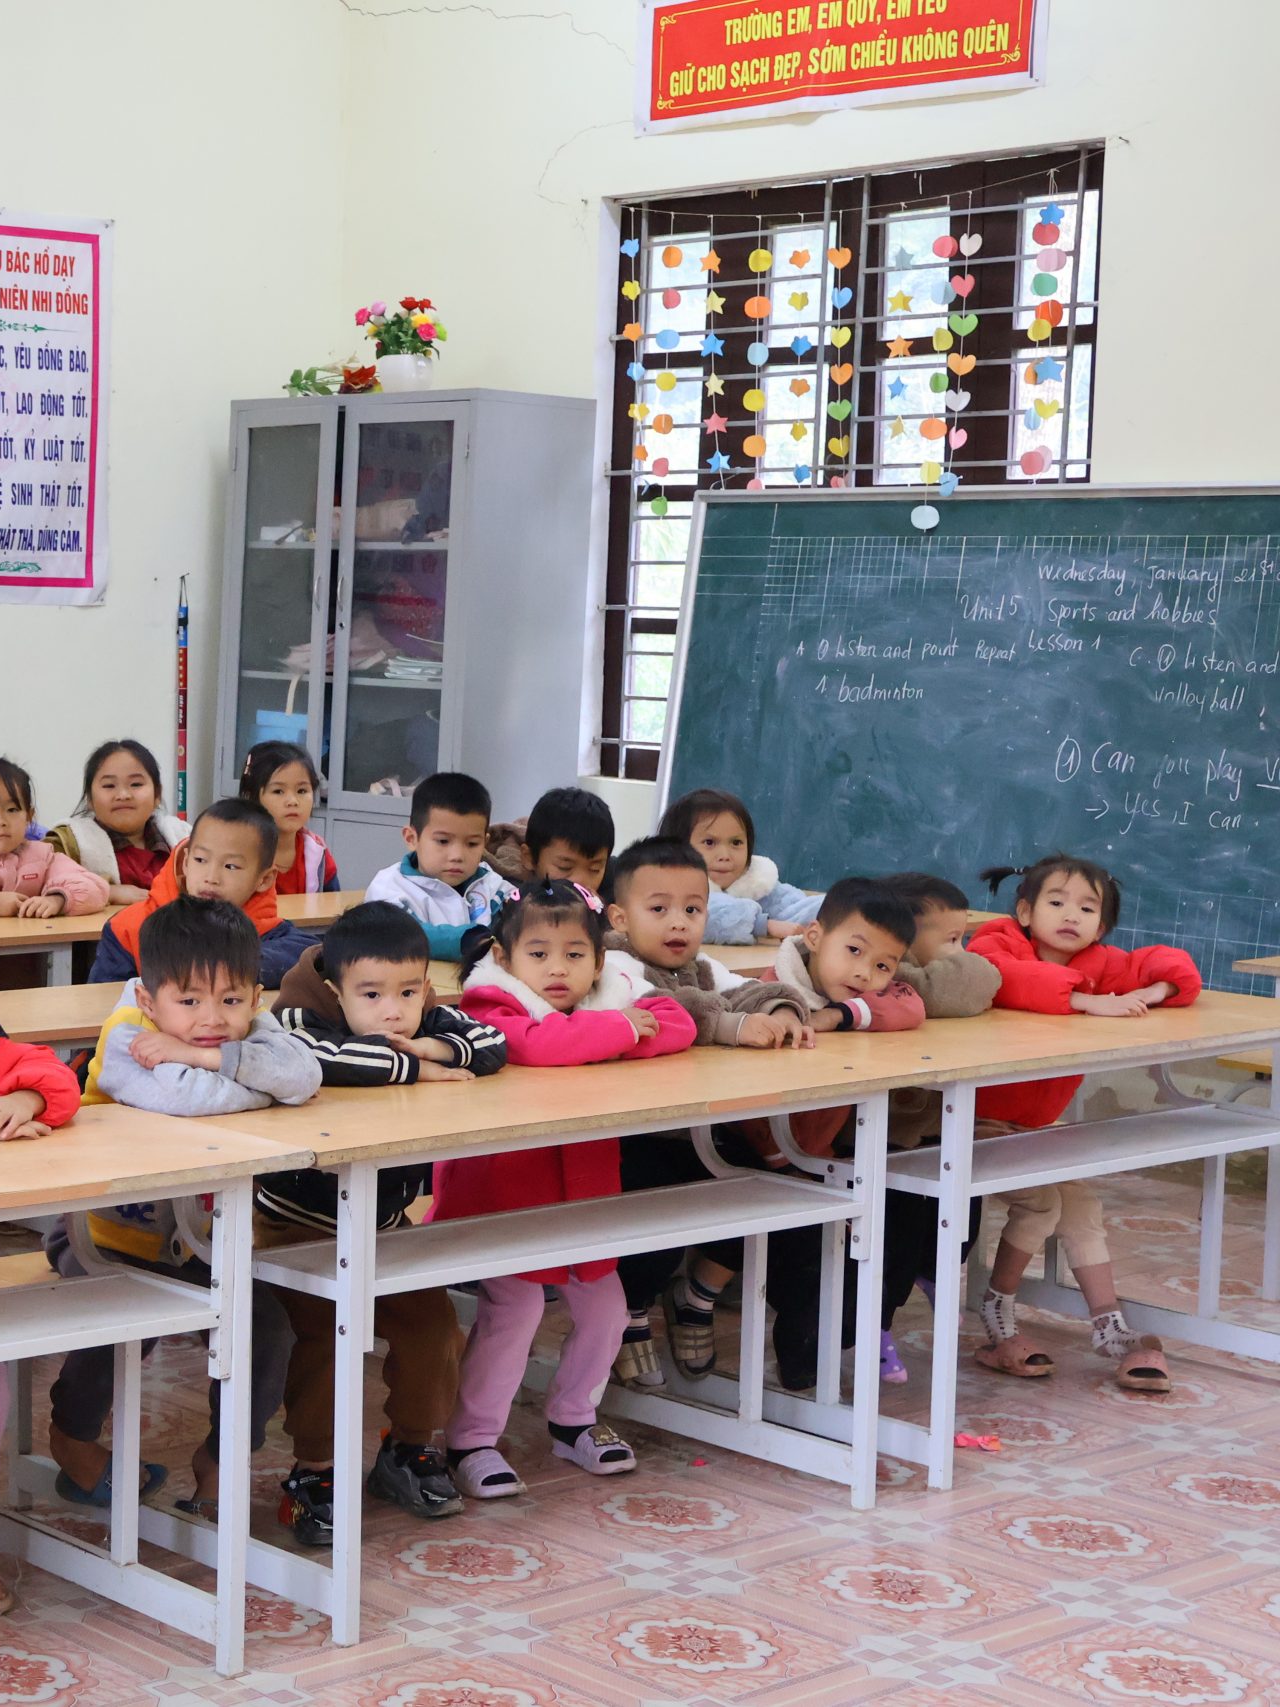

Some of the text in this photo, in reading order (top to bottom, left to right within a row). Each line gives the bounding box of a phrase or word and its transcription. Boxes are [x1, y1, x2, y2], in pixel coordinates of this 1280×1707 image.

[724, 8, 783, 46] TRƯỜNG
[787, 6, 812, 34] EM,
[817, 0, 842, 29] EM
[670, 19, 1010, 97] GIỮ CHO SẠCH ĐẸP, SỚM CHIỀU KHÔNG QUÊN
[6, 246, 30, 274] BÁC
[34, 246, 50, 275] HỒ
[53, 254, 75, 282] DẠY
[0, 283, 28, 311] NIÊN
[32, 289, 52, 313] NHI
[56, 285, 88, 315] ĐỒNG
[14, 342, 31, 370] YÊU
[37, 340, 63, 371] ĐỒNG
[69, 346, 89, 373] BÀO.
[16, 391, 33, 415] LAO
[40, 389, 65, 421] ĐỘNG
[72, 387, 88, 418] TỐT.
[24, 428, 36, 461] KỶ
[43, 434, 64, 467] LUẬT
[70, 432, 86, 463] TỐT.
[11, 482, 33, 506] SINH
[40, 480, 61, 512] THẬT
[67, 477, 84, 508] TỐT.
[17, 524, 36, 554] THÀ,
[60, 520, 83, 552] CẢM.
[1147, 565, 1219, 602] January
[960, 592, 1217, 628] Unit 5 Sports and hobbies
[836, 634, 877, 658] Listen
[883, 637, 913, 660] and
[922, 636, 959, 661] point
[1028, 629, 1102, 652] Lesson 1
[838, 672, 924, 703] badminton
[1092, 742, 1136, 773] Can
[1153, 754, 1190, 789] you
[1206, 749, 1243, 802] play
